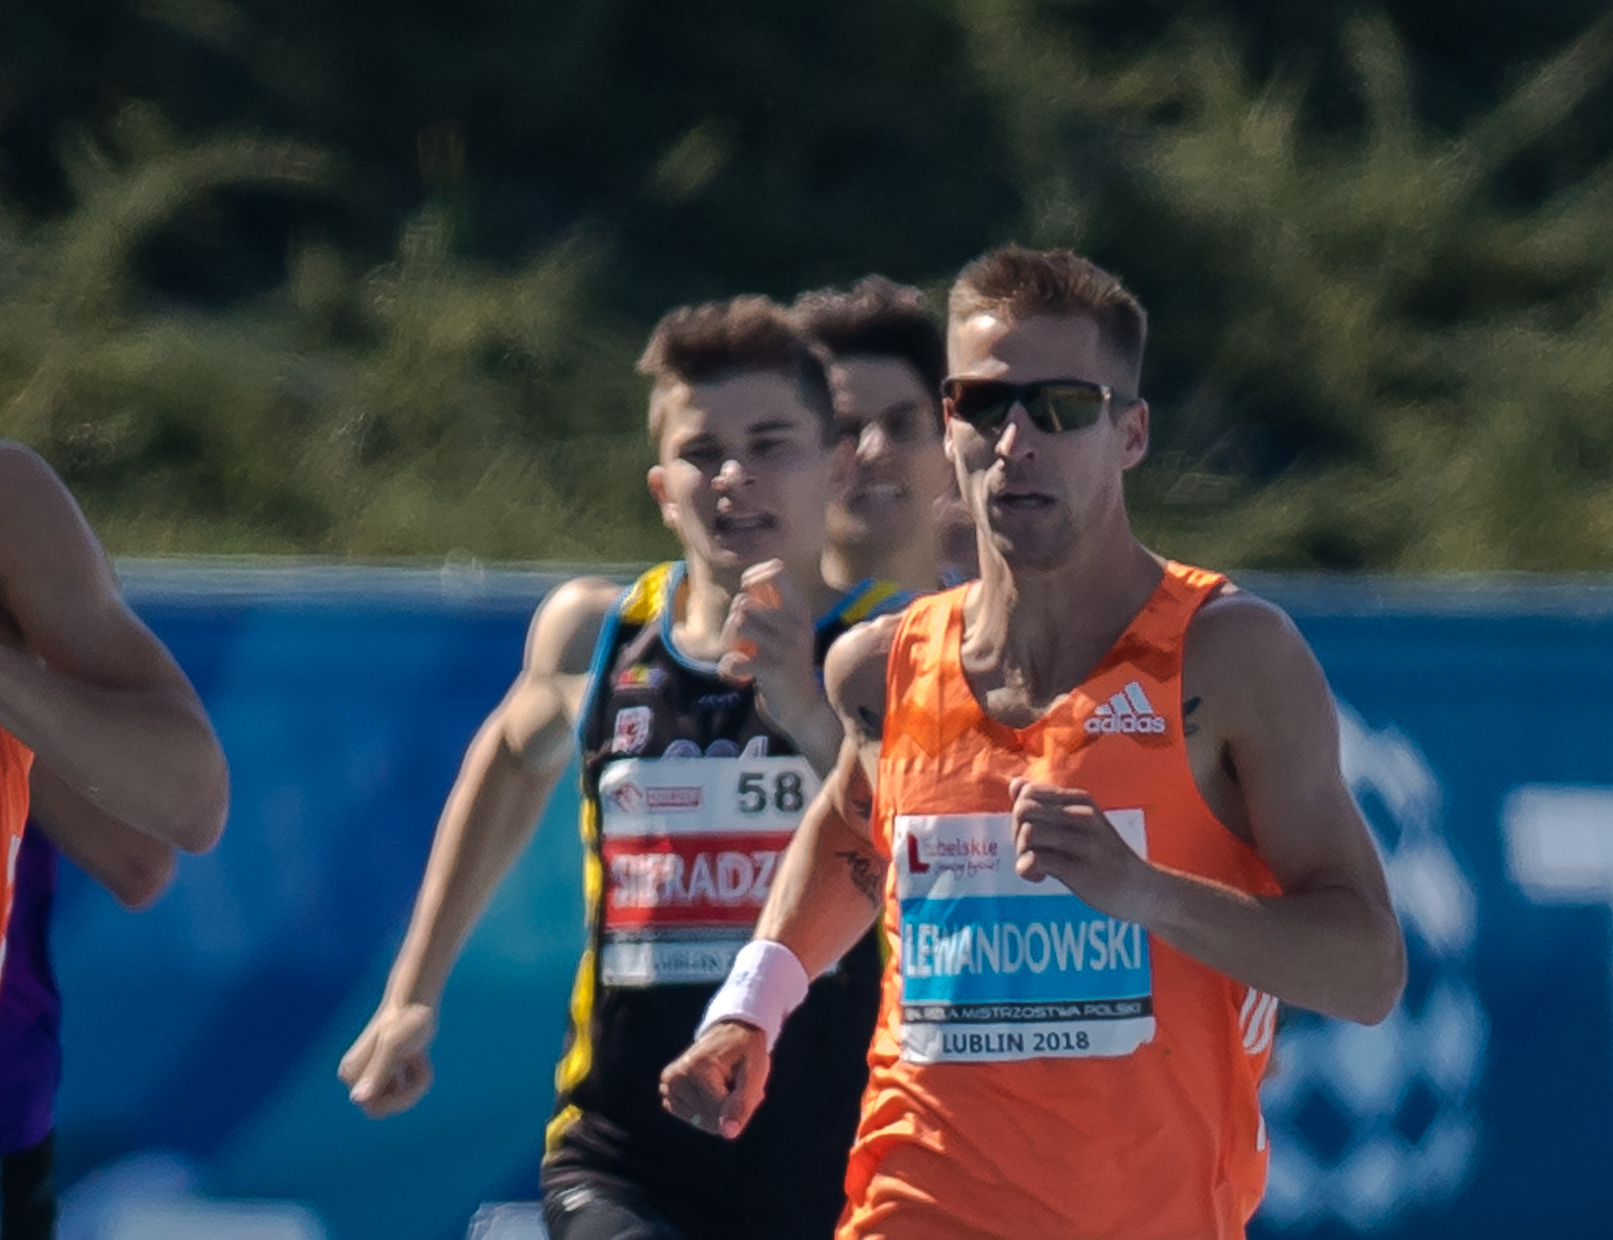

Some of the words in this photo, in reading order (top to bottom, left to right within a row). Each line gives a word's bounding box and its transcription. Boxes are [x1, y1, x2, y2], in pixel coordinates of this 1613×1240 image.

[1084, 712, 1166, 733] adidas
[739, 771, 804, 812] 58
[904, 918, 1142, 979] LEWANDOWSKI
[942, 1033, 1025, 1054] LUBLIN
[1033, 1031, 1091, 1052] 2018
